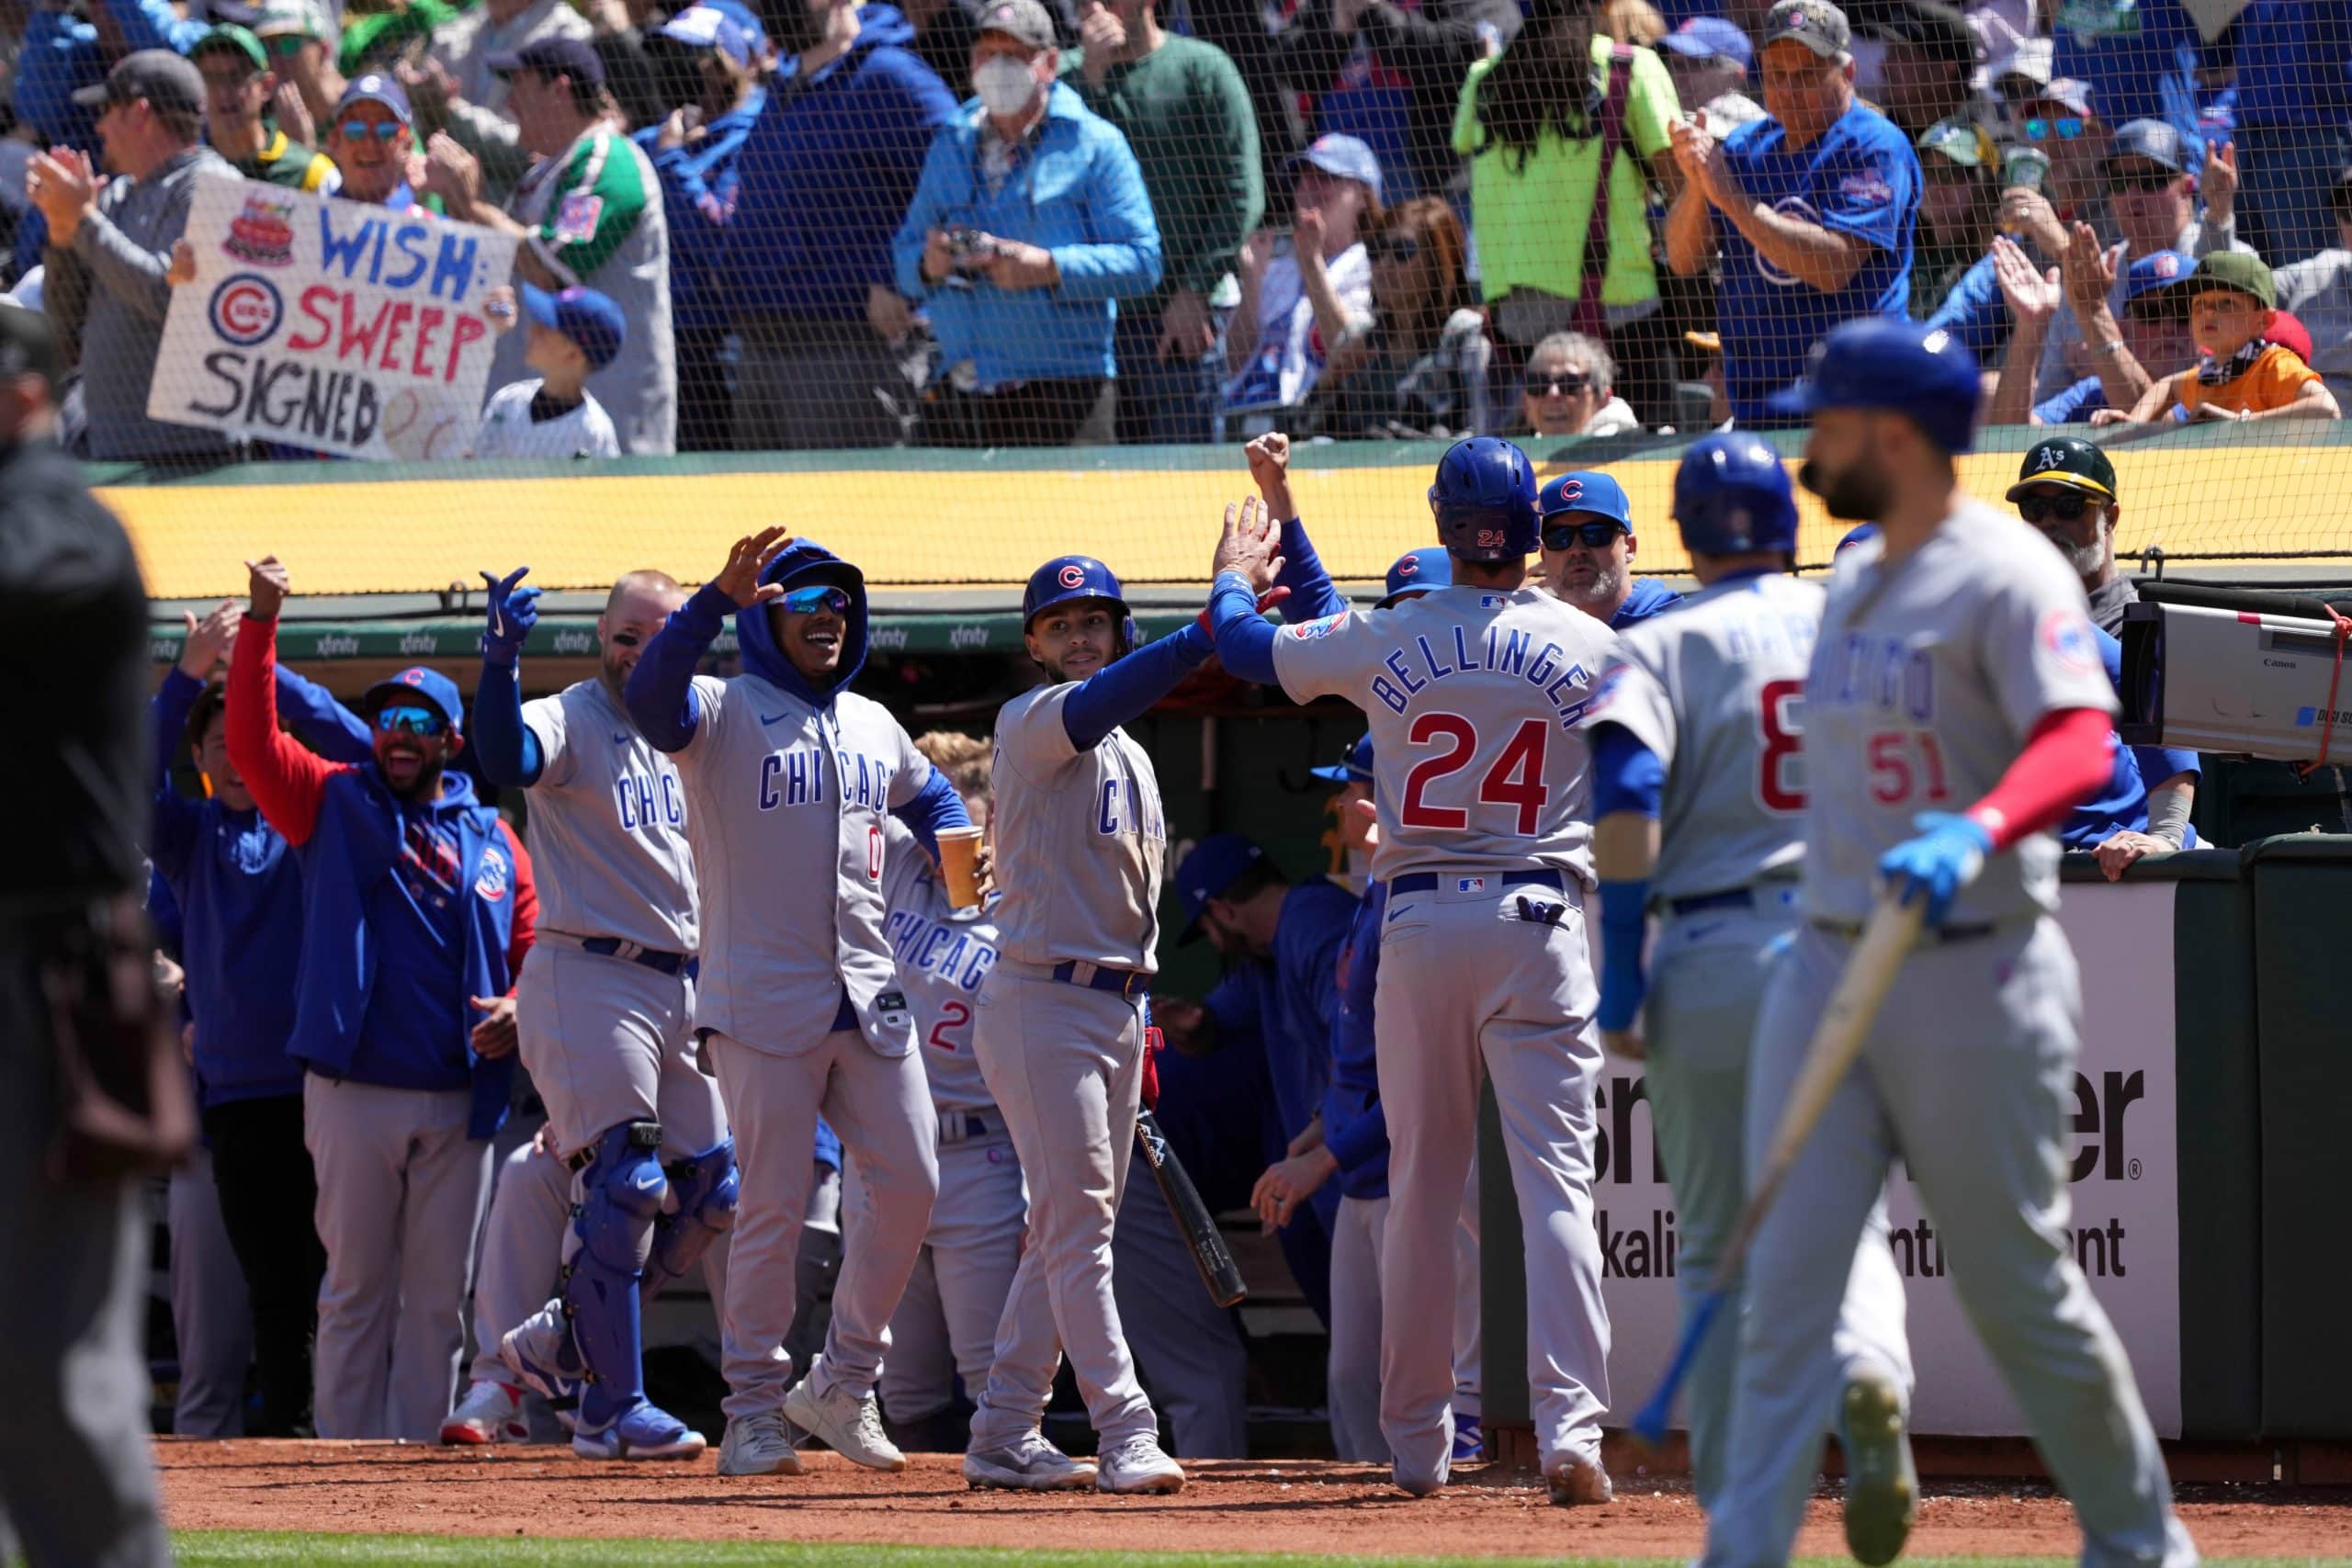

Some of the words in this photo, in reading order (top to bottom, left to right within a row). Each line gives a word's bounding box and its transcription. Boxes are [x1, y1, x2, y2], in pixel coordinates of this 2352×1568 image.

[319, 205, 489, 302] WISH:
[287, 284, 487, 383] SWEEP
[1561, 479, 1583, 502] C
[1477, 529, 1506, 547] 24
[1057, 565, 1085, 589] C
[1397, 555, 1419, 577] C
[403, 669, 425, 686] C
[2263, 658, 2297, 670] Canon
[759, 748, 897, 813] CHICAG
[1401, 710, 1551, 837] 24
[1868, 731, 1951, 806] 51
[885, 910, 1001, 990] CHICAG
[929, 999, 970, 1052] 2
